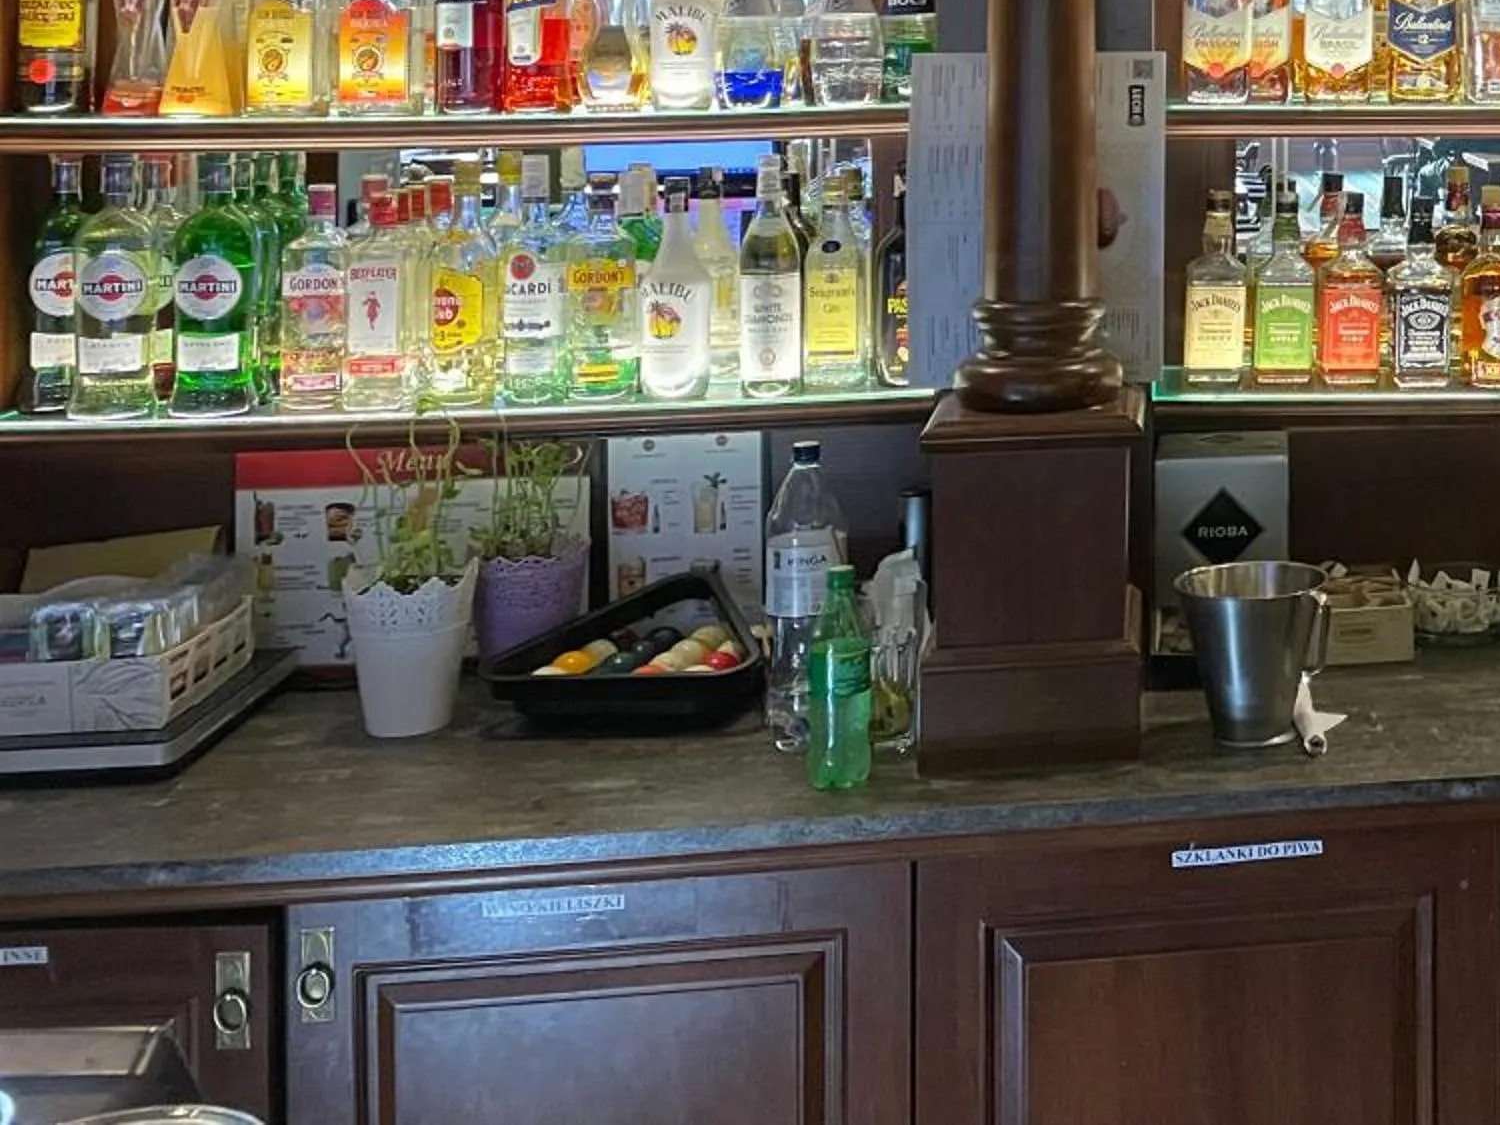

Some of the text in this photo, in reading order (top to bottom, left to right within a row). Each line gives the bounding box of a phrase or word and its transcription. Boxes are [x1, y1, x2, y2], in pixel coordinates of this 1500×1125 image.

[1132, 88, 1142, 114] LECH
[350, 267, 398, 282] BEEFEATER
[36, 278, 74, 292] MART
[81, 279, 142, 296] MARTINI
[178, 280, 237, 295] MARTINI
[504, 282, 551, 297] CARDI
[1401, 297, 1448, 317] JACK DANIEL'S
[1197, 525, 1249, 539] RIOBA
[1175, 842, 1321, 864] SZKLANKI DO PIWA
